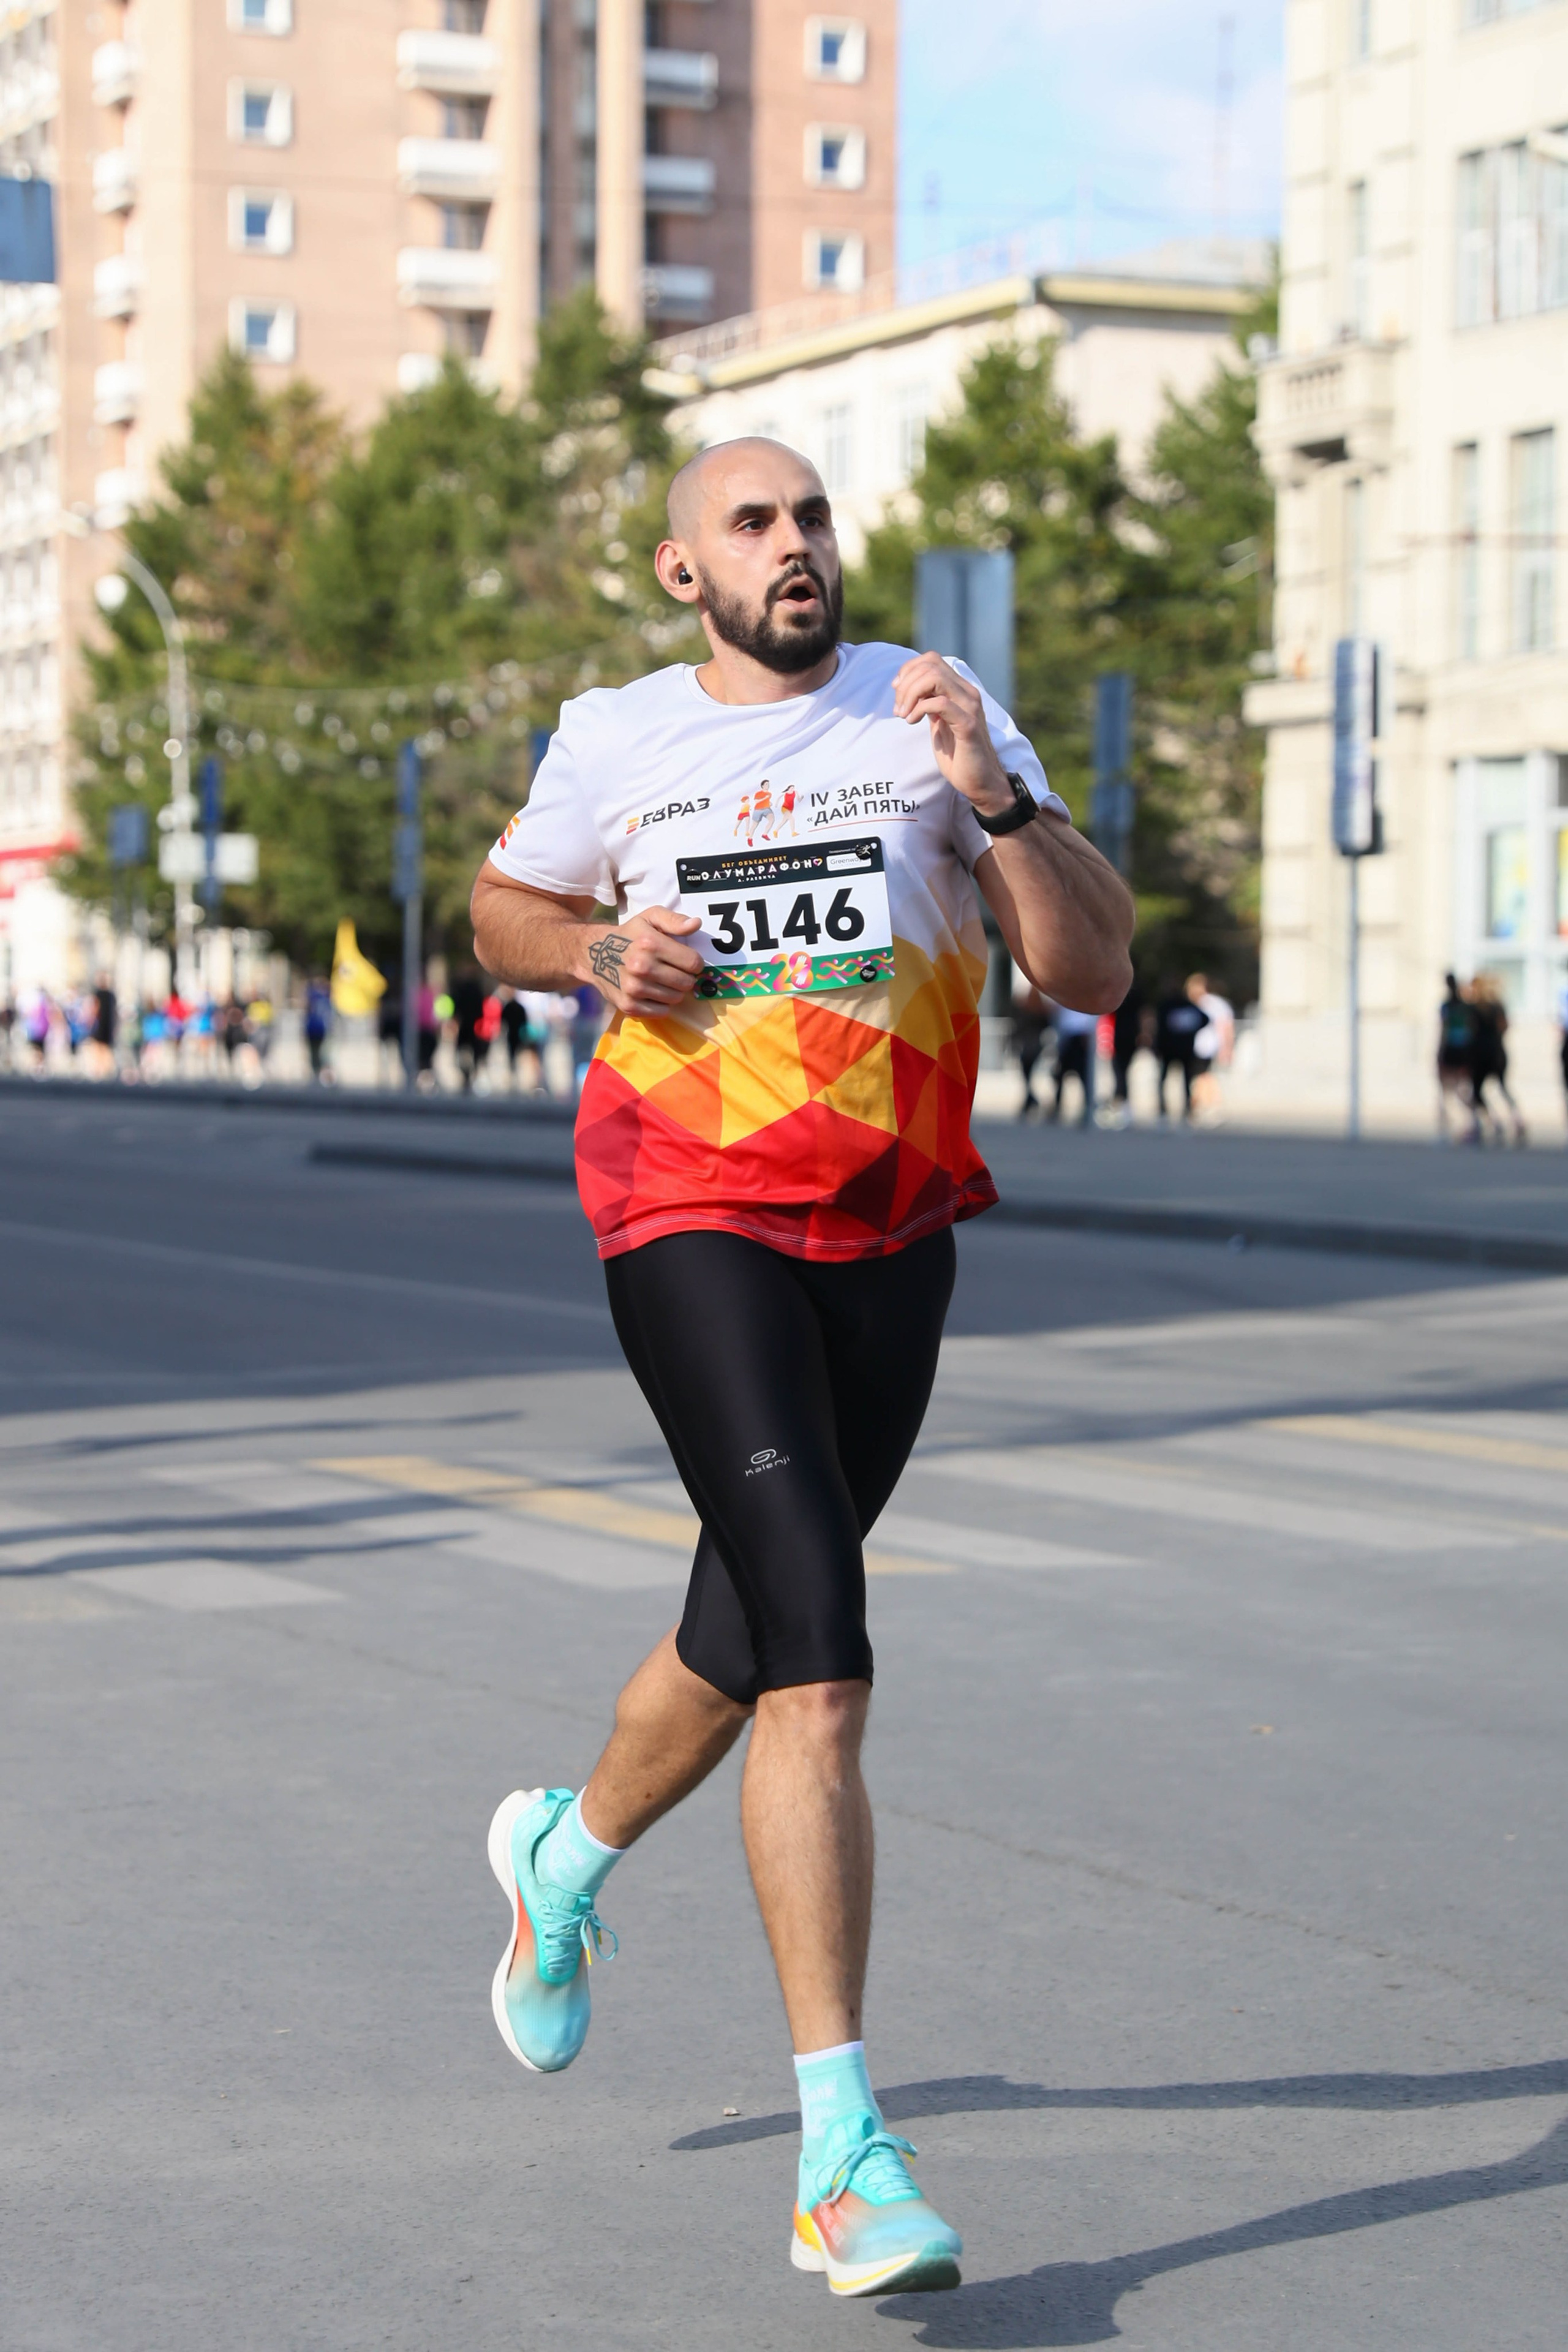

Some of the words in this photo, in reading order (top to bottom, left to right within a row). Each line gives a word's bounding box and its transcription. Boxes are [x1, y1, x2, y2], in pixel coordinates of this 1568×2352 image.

[810, 791, 829, 807] IV
[837, 782, 894, 802] ЗАБЕГ
[639, 797, 711, 828] ЕВРАЗ
[701, 859, 813, 881] ОЛУМАРАФОН
[738, 856, 788, 867] ОБЪЕДИНЯЕТ
[707, 888, 865, 954] 3146
